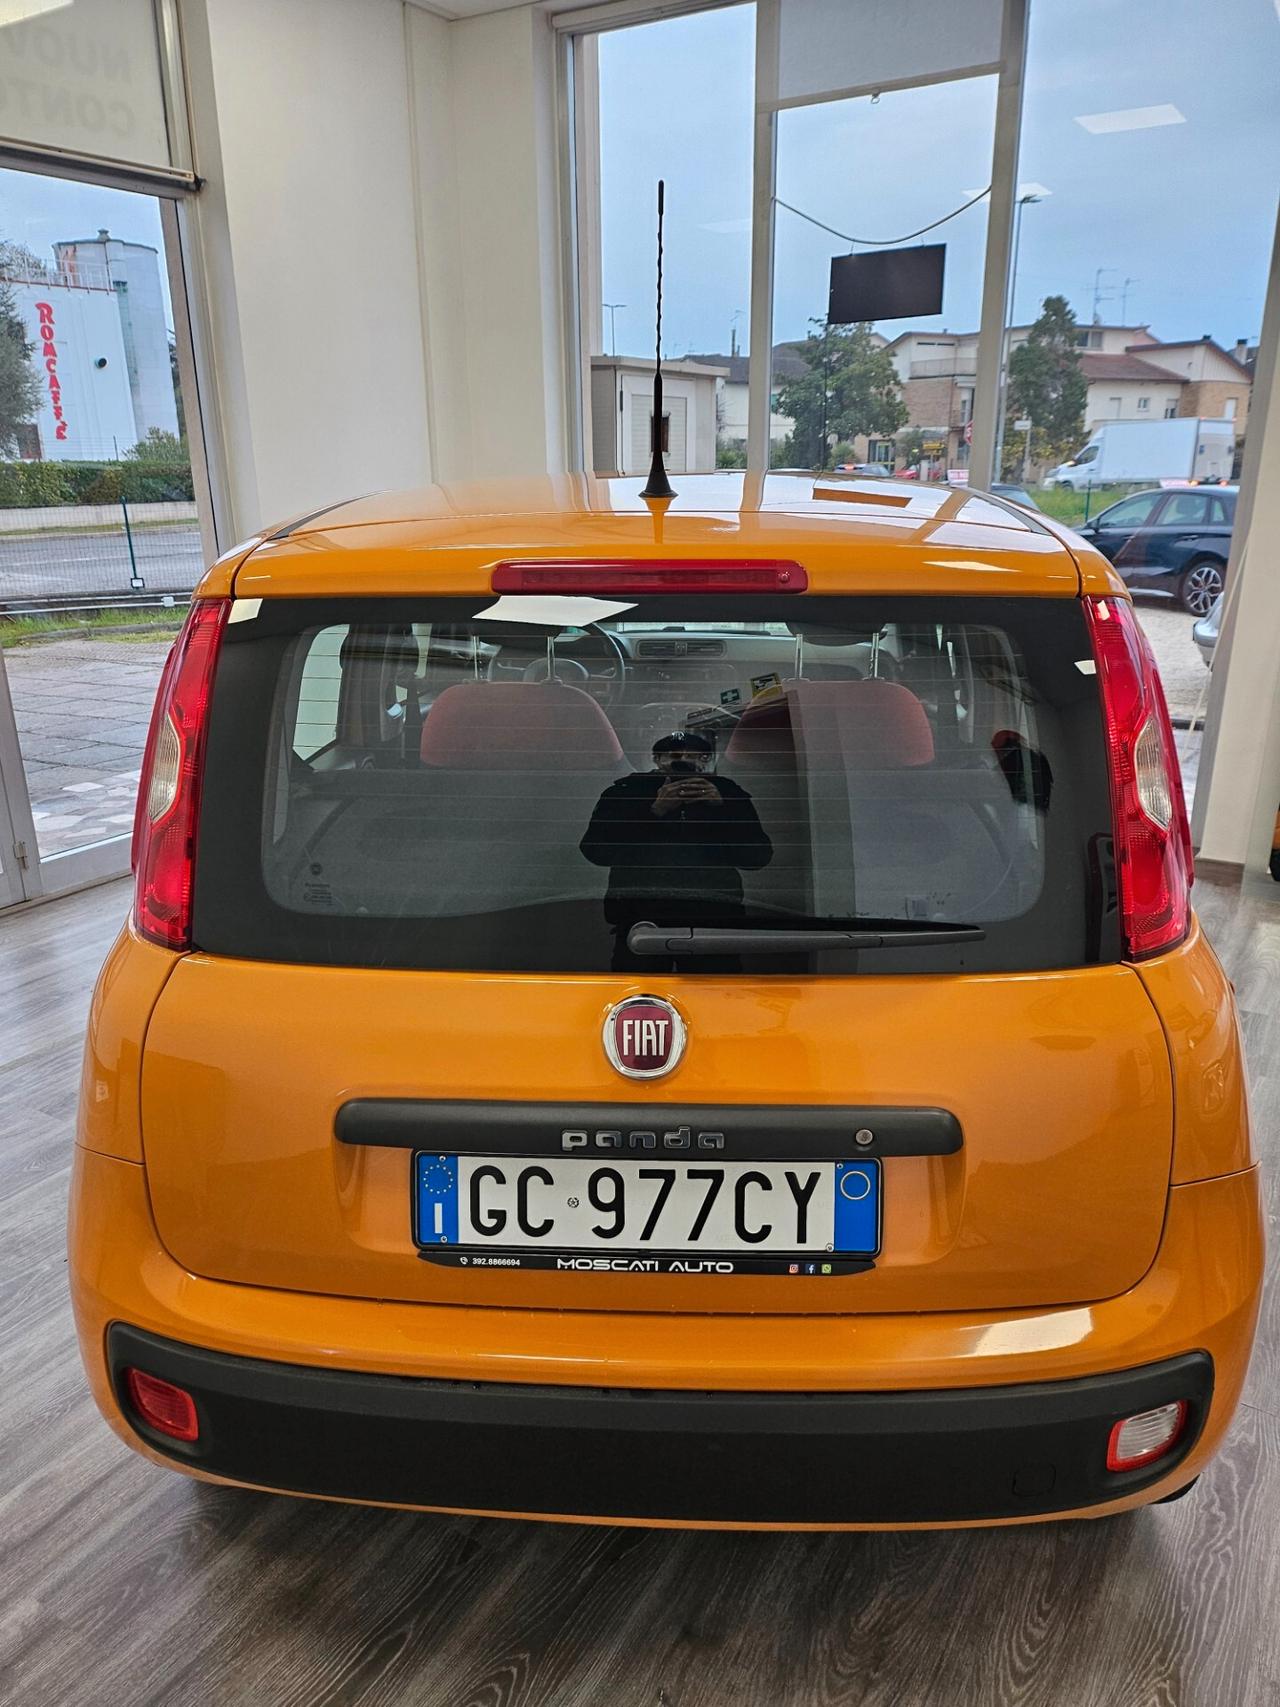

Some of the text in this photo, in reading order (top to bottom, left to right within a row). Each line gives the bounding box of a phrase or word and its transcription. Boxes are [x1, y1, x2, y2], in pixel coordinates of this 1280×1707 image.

[623, 1019, 669, 1056] FIAT
[562, 1125, 725, 1151] panda
[469, 1165, 822, 1244] GC 977CY
[557, 1258, 734, 1273] MOSCATI AUTO
